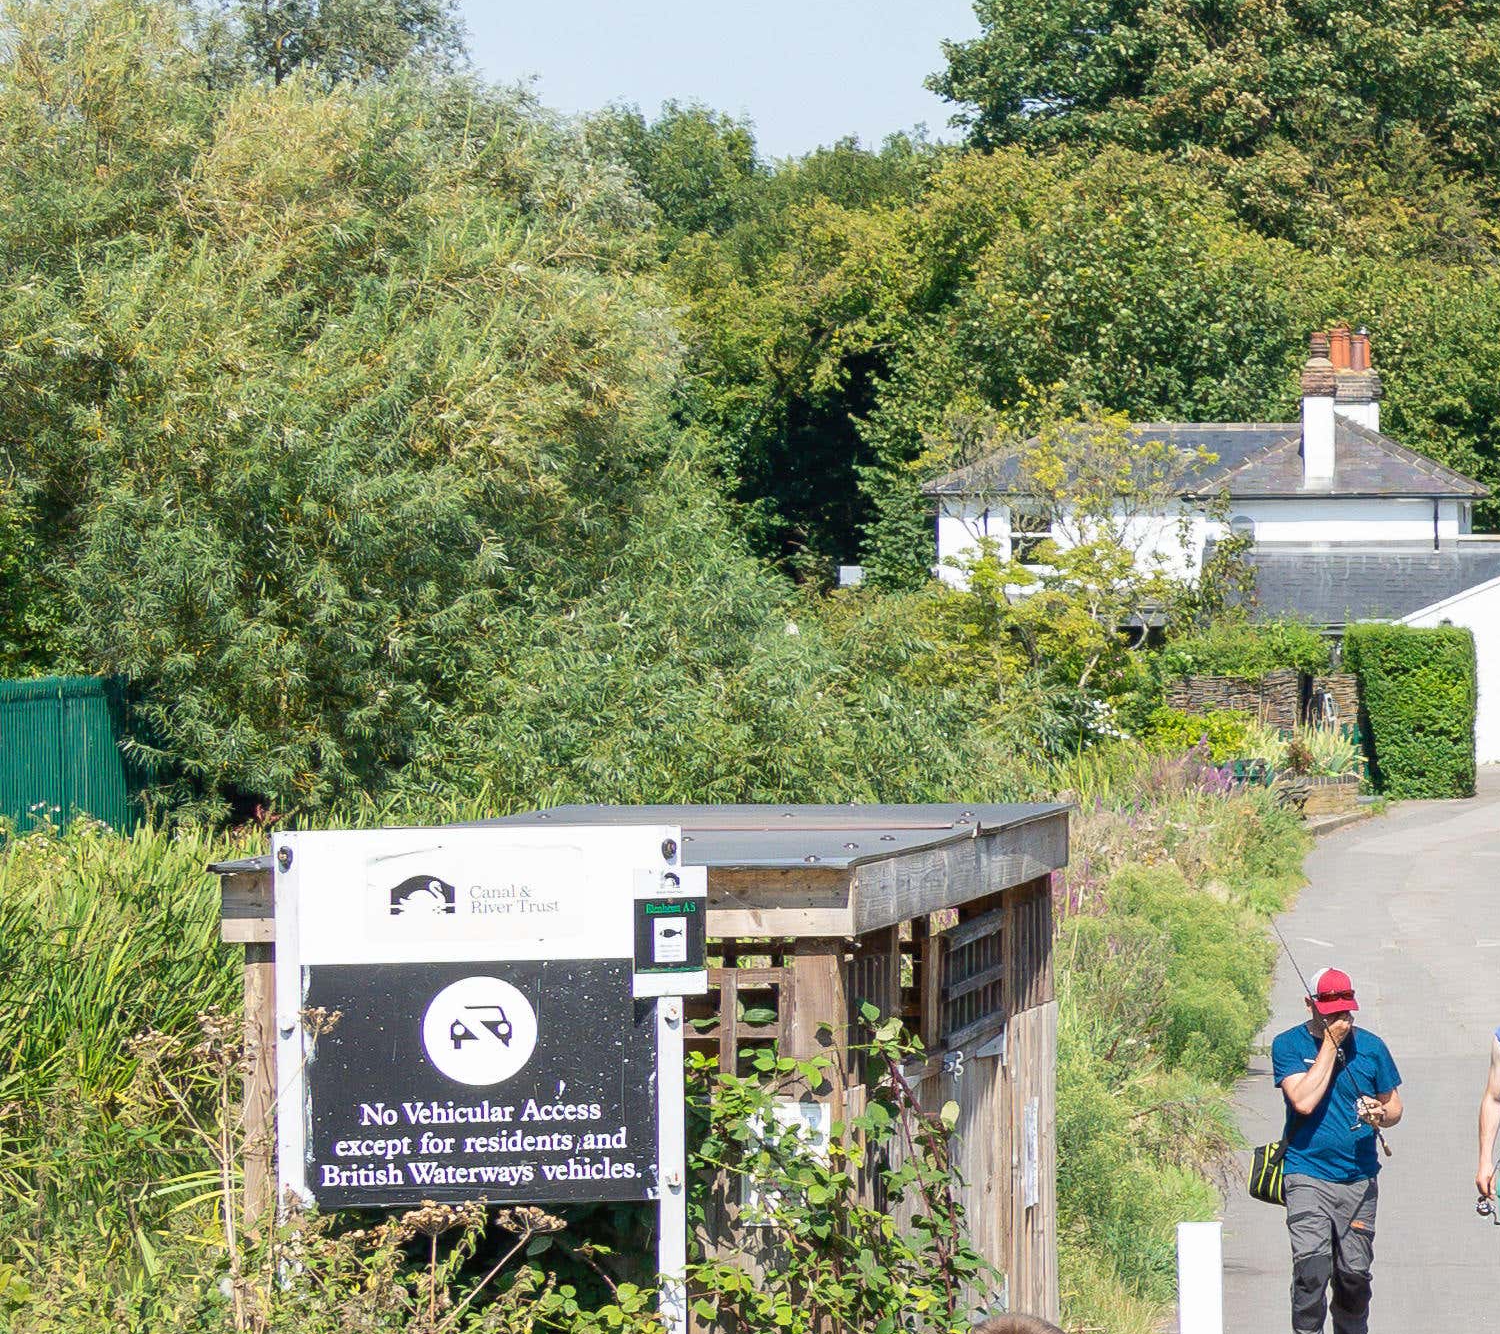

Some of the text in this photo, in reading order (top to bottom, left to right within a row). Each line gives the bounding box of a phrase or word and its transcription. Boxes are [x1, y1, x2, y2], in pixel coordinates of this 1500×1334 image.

[469, 884, 532, 899] Canal &
[471, 899, 560, 914] River Trust
[360, 1099, 602, 1126] No Vehicular Access
[335, 1127, 627, 1160] except for residents and
[320, 1156, 642, 1187] British Waterways vehicles.
